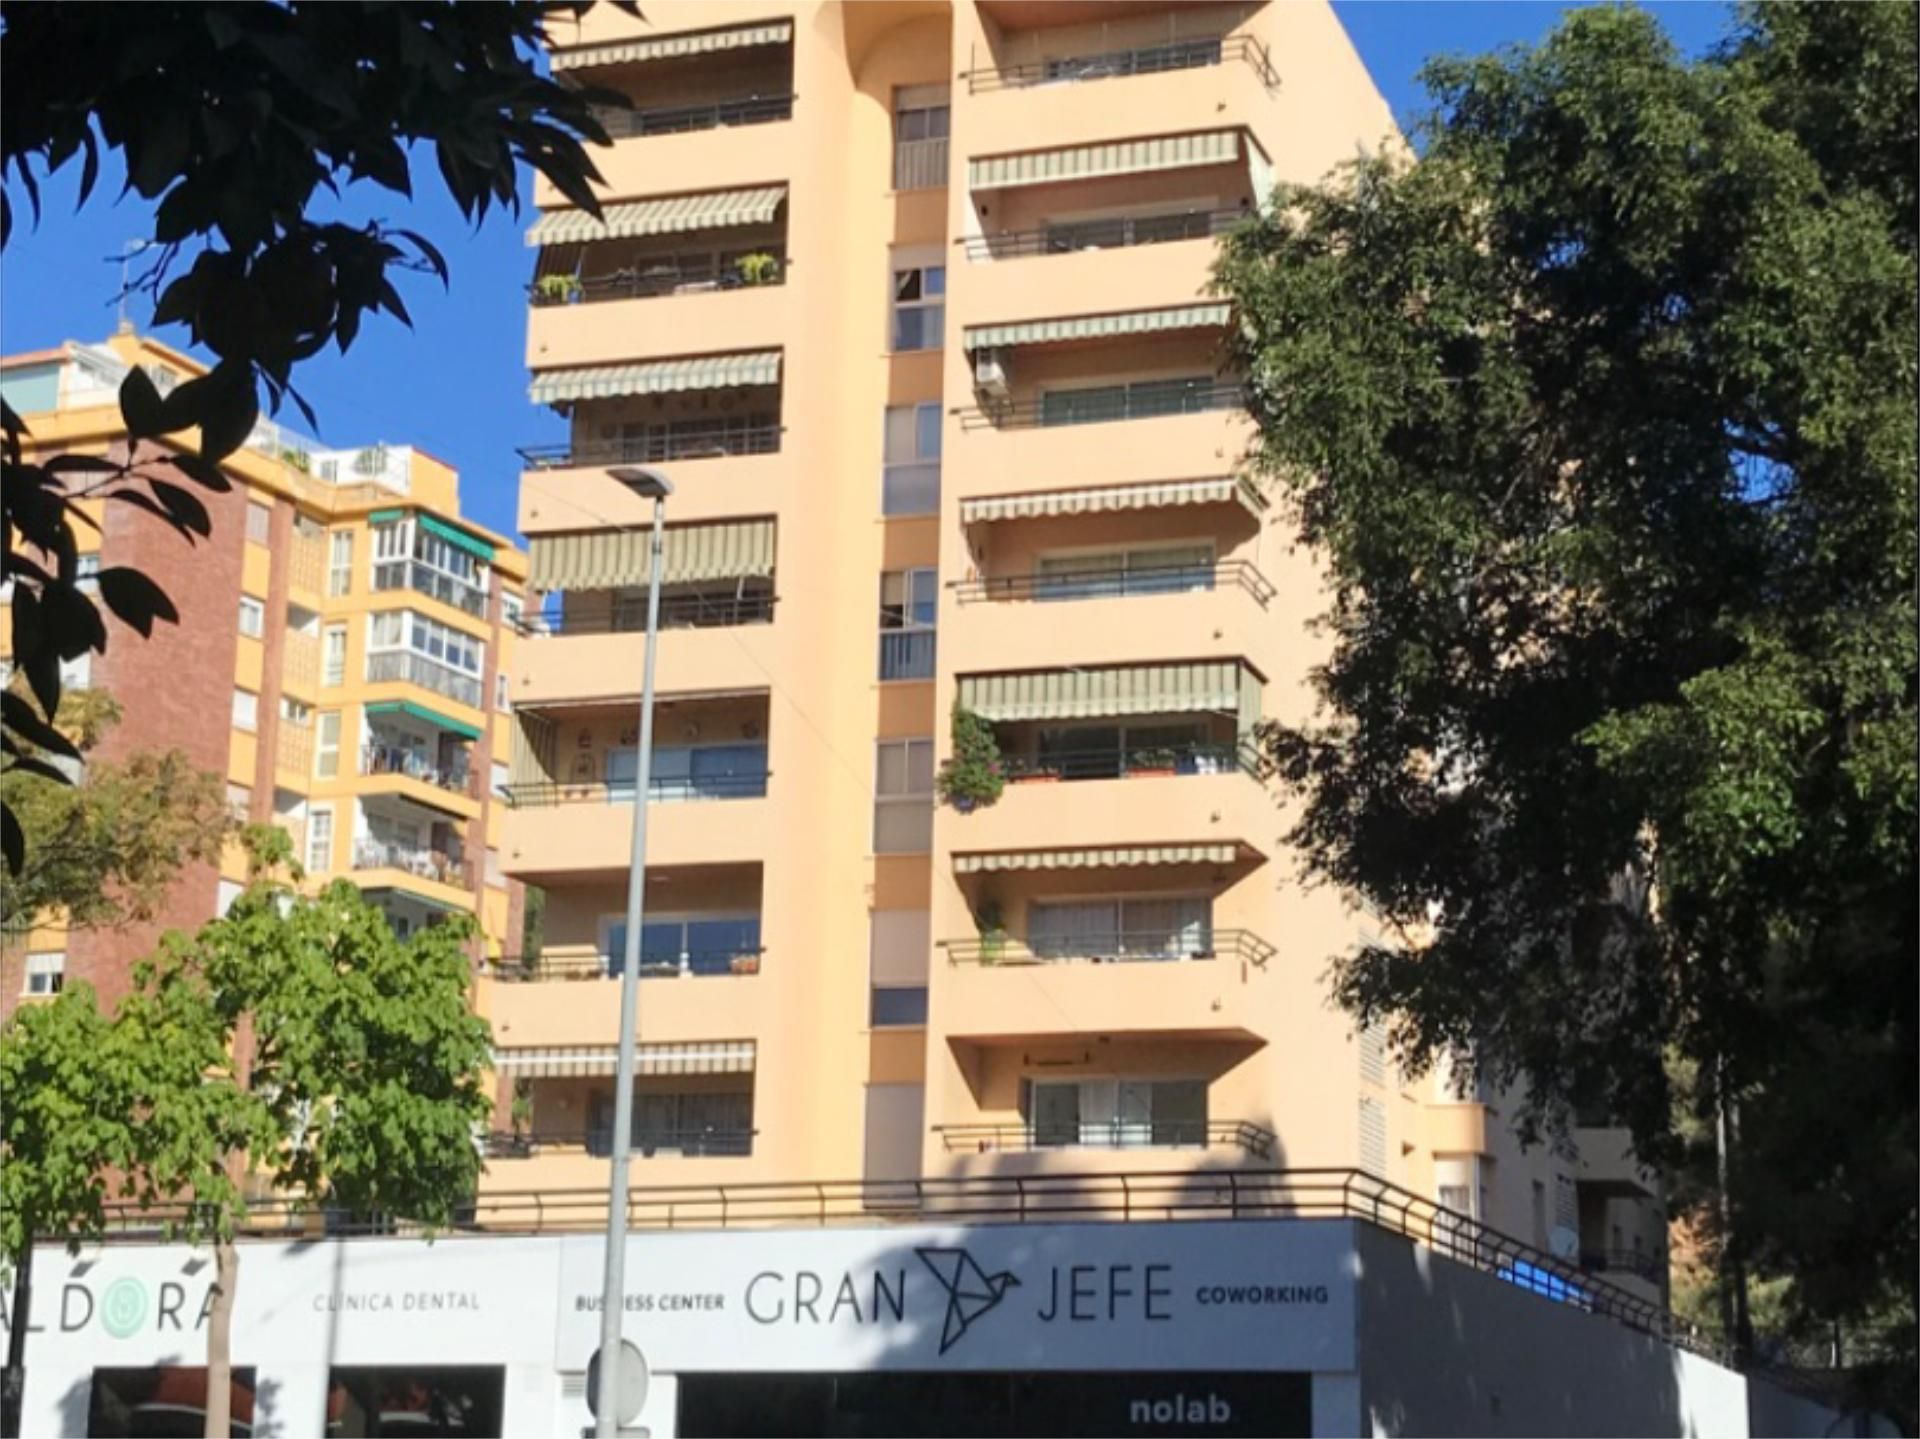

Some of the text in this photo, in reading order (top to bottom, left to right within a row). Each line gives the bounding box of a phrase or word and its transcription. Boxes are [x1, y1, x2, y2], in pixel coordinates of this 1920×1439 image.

[402, 1292, 480, 1311] DENTAL
[575, 1293, 725, 1312] BUSESS CENTER
[744, 1264, 1172, 1324] GRAN JEFE
[1196, 1285, 1329, 1305] COWORKING
[0, 1276, 217, 1339] DORA
[1130, 1394, 1232, 1424] nolab
